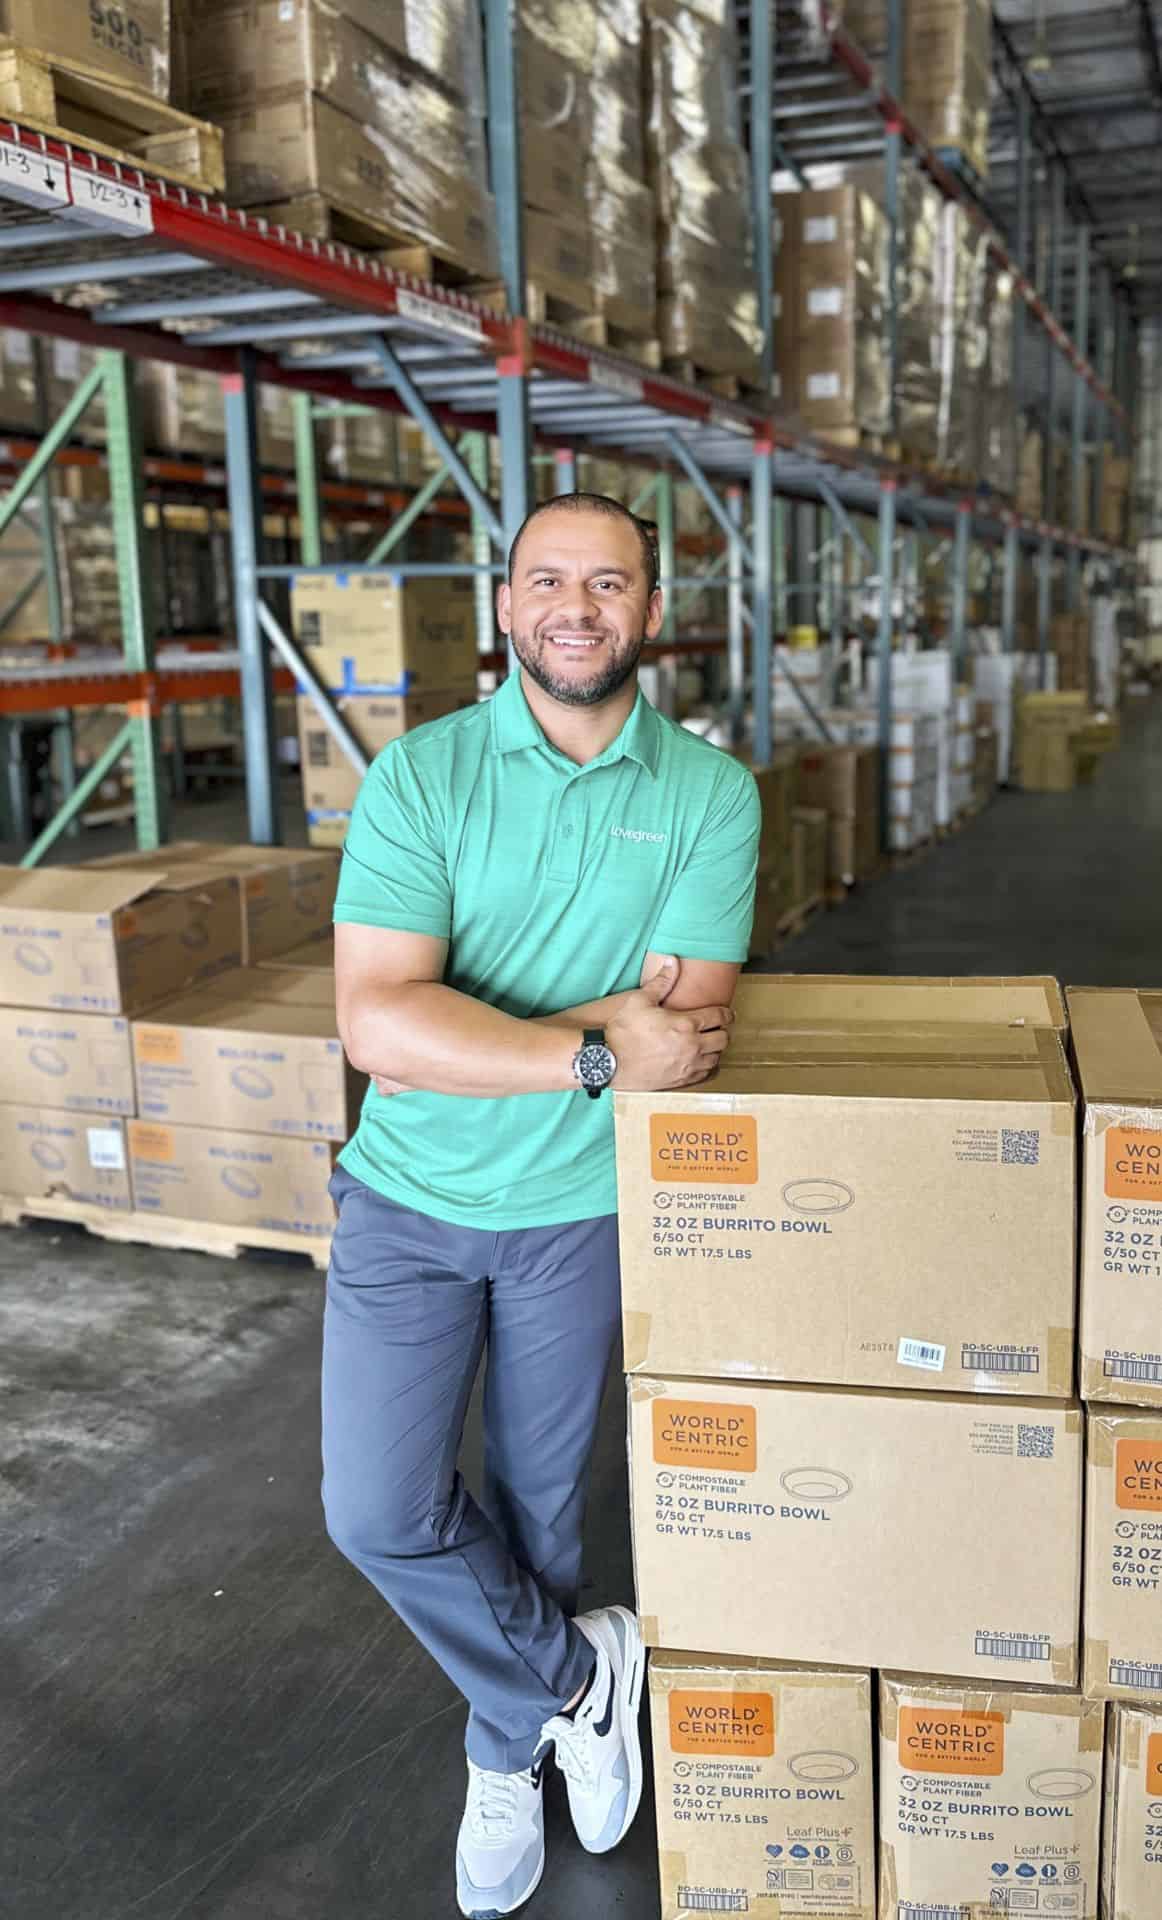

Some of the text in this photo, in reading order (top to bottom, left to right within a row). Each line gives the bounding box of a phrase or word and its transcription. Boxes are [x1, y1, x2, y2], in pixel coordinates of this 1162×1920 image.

[666, 1131, 739, 1146] WORLD
[658, 1148, 749, 1162] CENTRIC
[677, 1193, 745, 1202] COMPOSTABLE
[677, 1202, 737, 1210] PLANT FIBER
[653, 1217, 832, 1234] 32 OZ BURRITO BOWL
[653, 1232, 704, 1244] 6/50 CT
[1104, 1230, 1153, 1245] 32 OZ
[654, 1246, 752, 1259] GR WT 17.5 LBS
[1104, 1247, 1160, 1261] 6/50 CT
[1104, 1262, 1122, 1272] GR
[1128, 1264, 1151, 1275] WT
[670, 1414, 740, 1431] WORLD
[662, 1430, 749, 1448] CENTRIC
[679, 1473, 746, 1487] COMPOSTABLE
[679, 1482, 737, 1494] PLANT FIBER
[656, 1495, 831, 1521] 32 OZ BURRITO BOWL
[656, 1510, 705, 1523] 6/50 CT
[656, 1523, 752, 1541] GR WT 17.5 LBS
[1113, 1545, 1161, 1560] 32 OZ
[1112, 1561, 1162, 1575] 6/50 C
[1112, 1576, 1160, 1589] GR WT
[686, 1706, 755, 1721] WORLD
[678, 1721, 764, 1736] CENTRIC
[916, 1722, 988, 1738] WORLD
[907, 1737, 995, 1753] CENTRIC
[695, 1763, 762, 1773] COMPOSTABLE
[696, 1771, 754, 1780] PLANT FIBER
[923, 1778, 991, 1790] COMPOSTABLE
[673, 1784, 845, 1800] 32 OZ BURRITO BOWL
[923, 1787, 982, 1797] PLANT FIBER
[673, 1798, 723, 1810] 6/50 CT
[898, 1795, 1073, 1817] 32 OZ BURRITO BOWL
[674, 1811, 769, 1824] GR WT 17.5 LBS
[898, 1809, 949, 1825] 6/50 CT
[786, 1826, 812, 1837] Leaf
[898, 1822, 994, 1841] GR WT 17.5 LBS
[1014, 1845, 1040, 1855] Leaf
